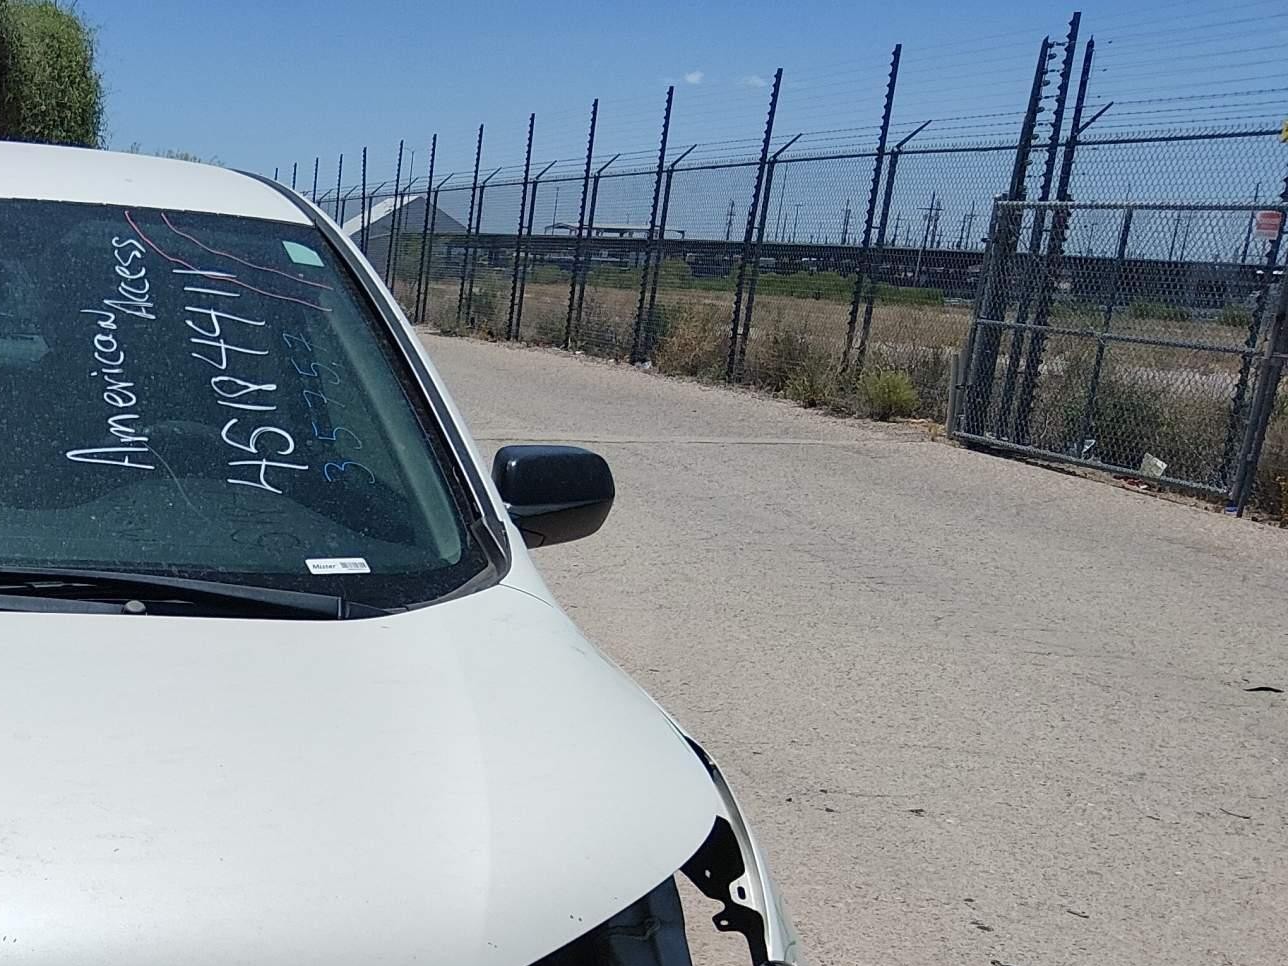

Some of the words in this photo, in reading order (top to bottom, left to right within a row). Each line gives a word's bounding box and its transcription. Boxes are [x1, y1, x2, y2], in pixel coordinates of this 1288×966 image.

[102, 236, 156, 320] Access
[66, 308, 155, 470] American
[171, 268, 310, 495] 45184411
